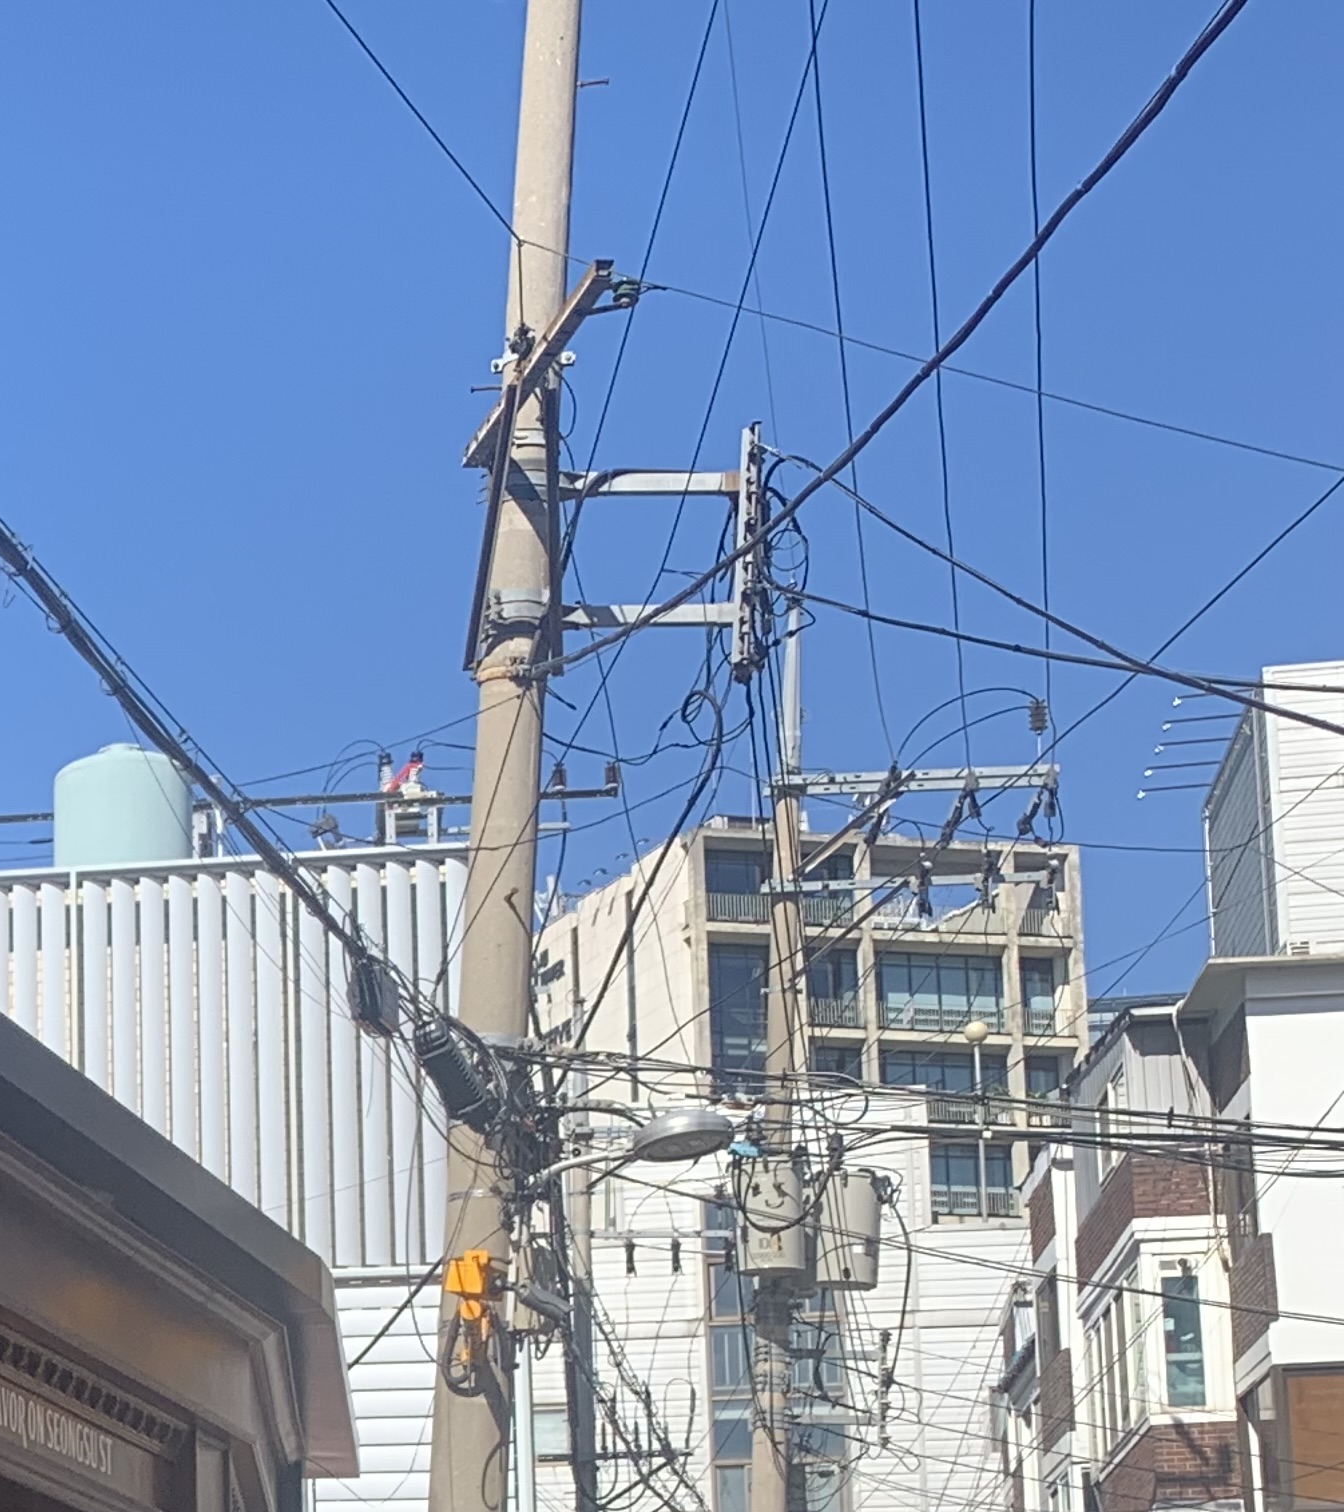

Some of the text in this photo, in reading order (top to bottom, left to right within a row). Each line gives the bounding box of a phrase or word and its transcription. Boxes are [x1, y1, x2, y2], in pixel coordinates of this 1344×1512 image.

[27, 1400, 45, 1445] ON
[46, 1409, 98, 1469] SEONGSU
[99, 1434, 112, 1475] ST
